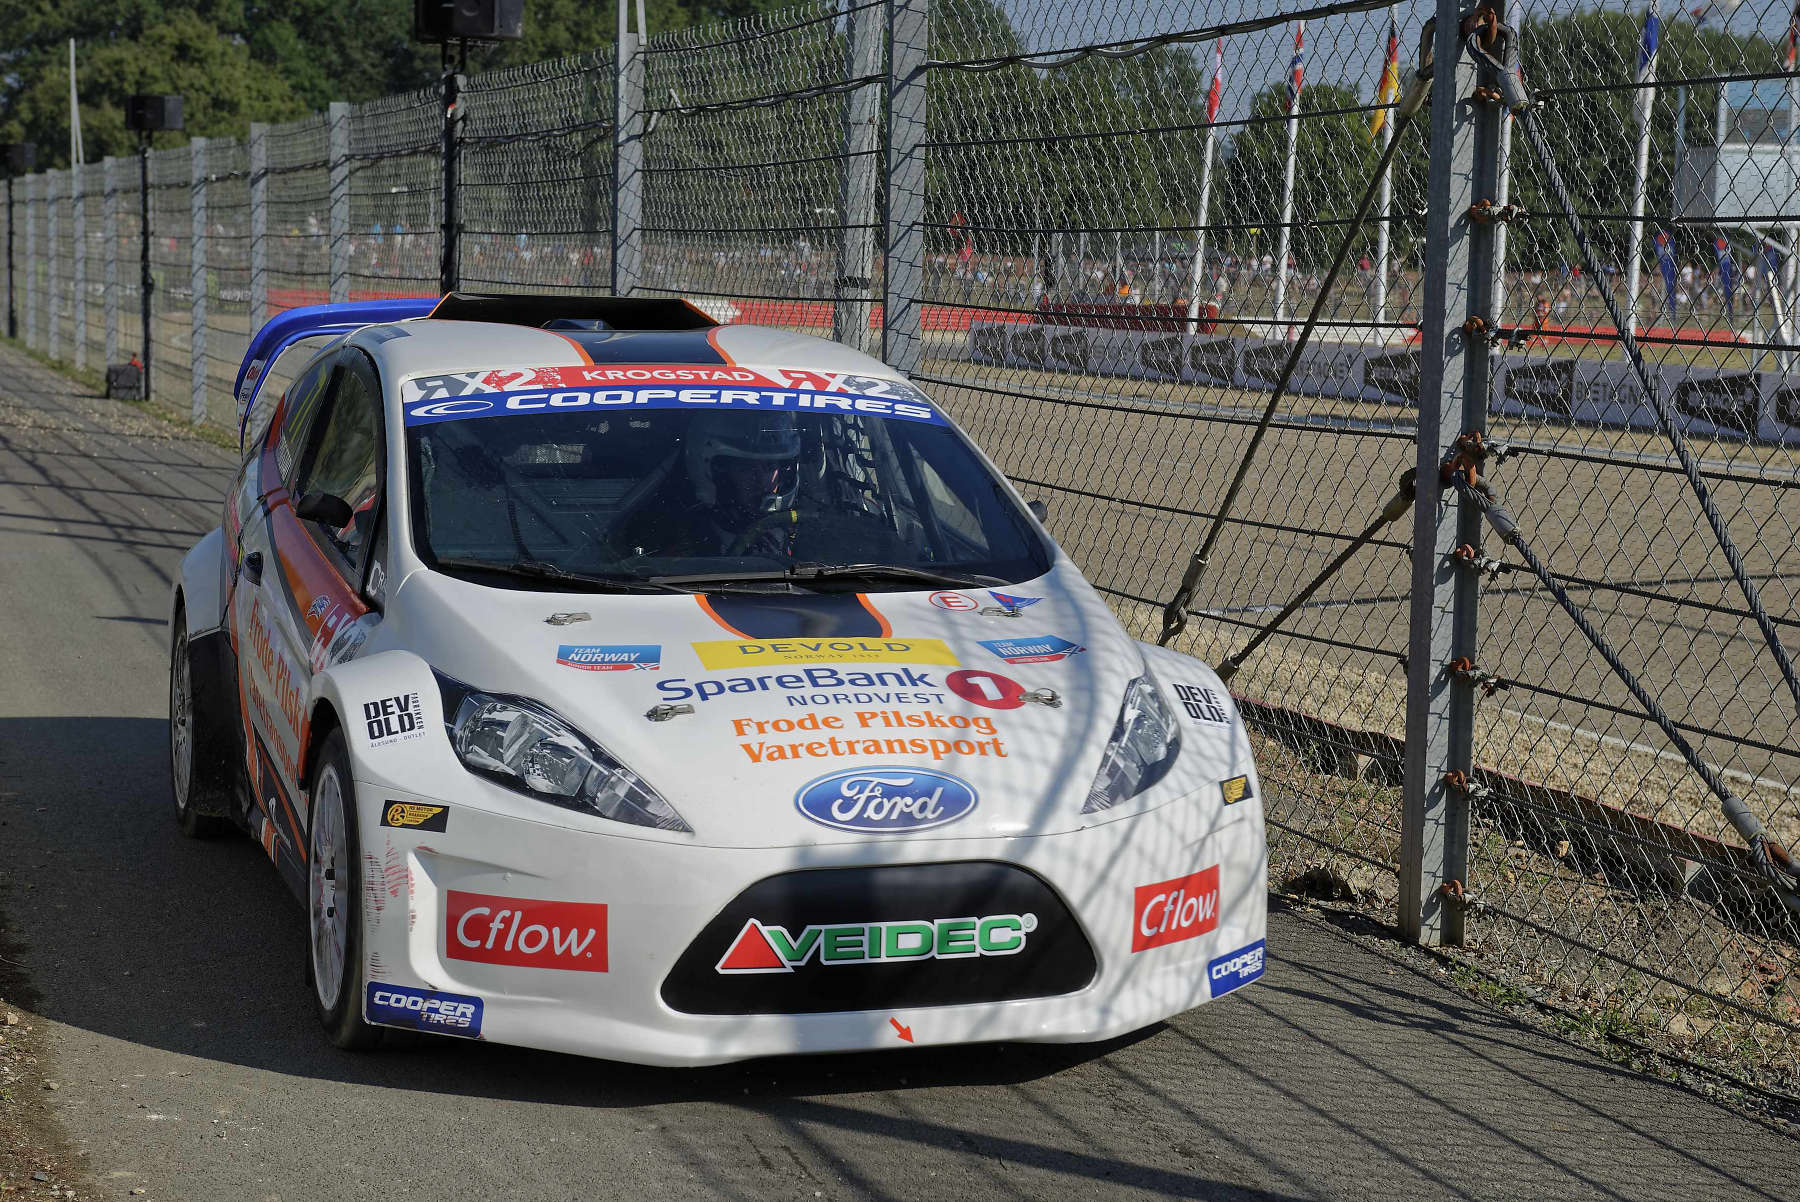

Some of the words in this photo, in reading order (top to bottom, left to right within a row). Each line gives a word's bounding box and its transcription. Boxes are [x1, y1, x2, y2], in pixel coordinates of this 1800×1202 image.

[582, 369, 755, 381] KROGSTAD
[938, 596, 969, 608] E
[249, 597, 275, 685] Frode
[737, 642, 912, 655] DEVOLD
[997, 644, 1054, 656] NORWAY
[567, 652, 641, 662] NORWAY
[656, 667, 939, 702] SpareBank
[965, 676, 1004, 701] 1
[1172, 683, 1213, 704] DEV
[363, 694, 410, 721] DEV
[786, 692, 946, 707] NORDVEST
[1183, 701, 1224, 722] OLD
[367, 712, 416, 740] OLD
[731, 711, 845, 737] Frode
[853, 710, 998, 736] Pilskog
[740, 735, 1008, 764] Varetransport
[831, 776, 945, 822] Ford
[1212, 946, 1264, 979] COOPER
[1238, 960, 1263, 978] TIRES
[373, 991, 475, 1017] COOPER
[420, 1011, 471, 1028] TIRES
